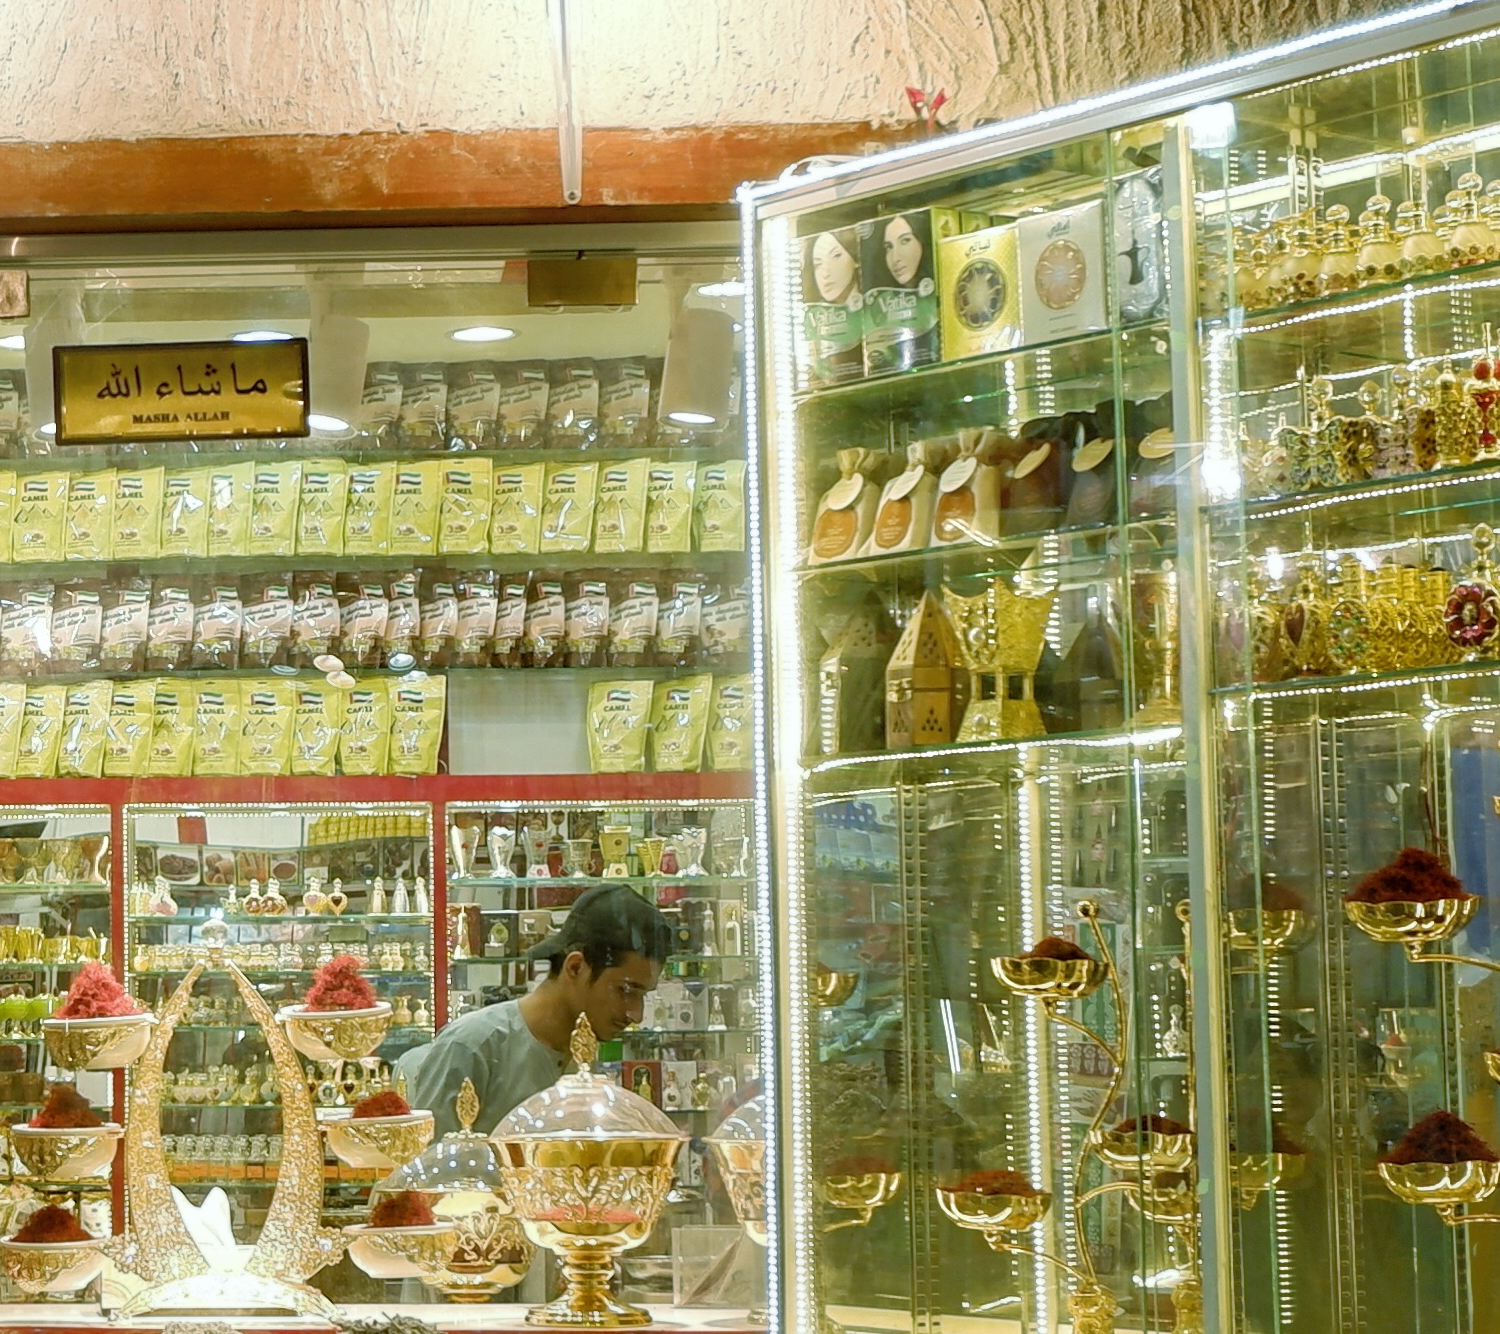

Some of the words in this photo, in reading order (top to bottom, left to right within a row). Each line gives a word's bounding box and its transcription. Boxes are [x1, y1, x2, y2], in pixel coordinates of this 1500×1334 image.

[877, 291, 918, 315] Vatika
[96, 363, 142, 399] الله
[155, 363, 222, 401] شاء
[231, 362, 268, 395] ما
[132, 412, 180, 424] MASHA
[184, 411, 231, 422] ALLAH
[302, 485, 330, 495] CAMEL
[394, 486, 423, 495] CAMEL
[444, 484, 474, 495] CAMEL
[495, 486, 523, 496] CAMEL
[548, 485, 576, 495] CAMEL
[600, 484, 628, 493] CAMEL
[21, 494, 49, 503] CAMEL
[68, 493, 97, 502] CAMEL
[196, 706, 226, 715] CAMEL
[296, 706, 324, 715] CAMEL
[394, 704, 424, 714] CAMEL
